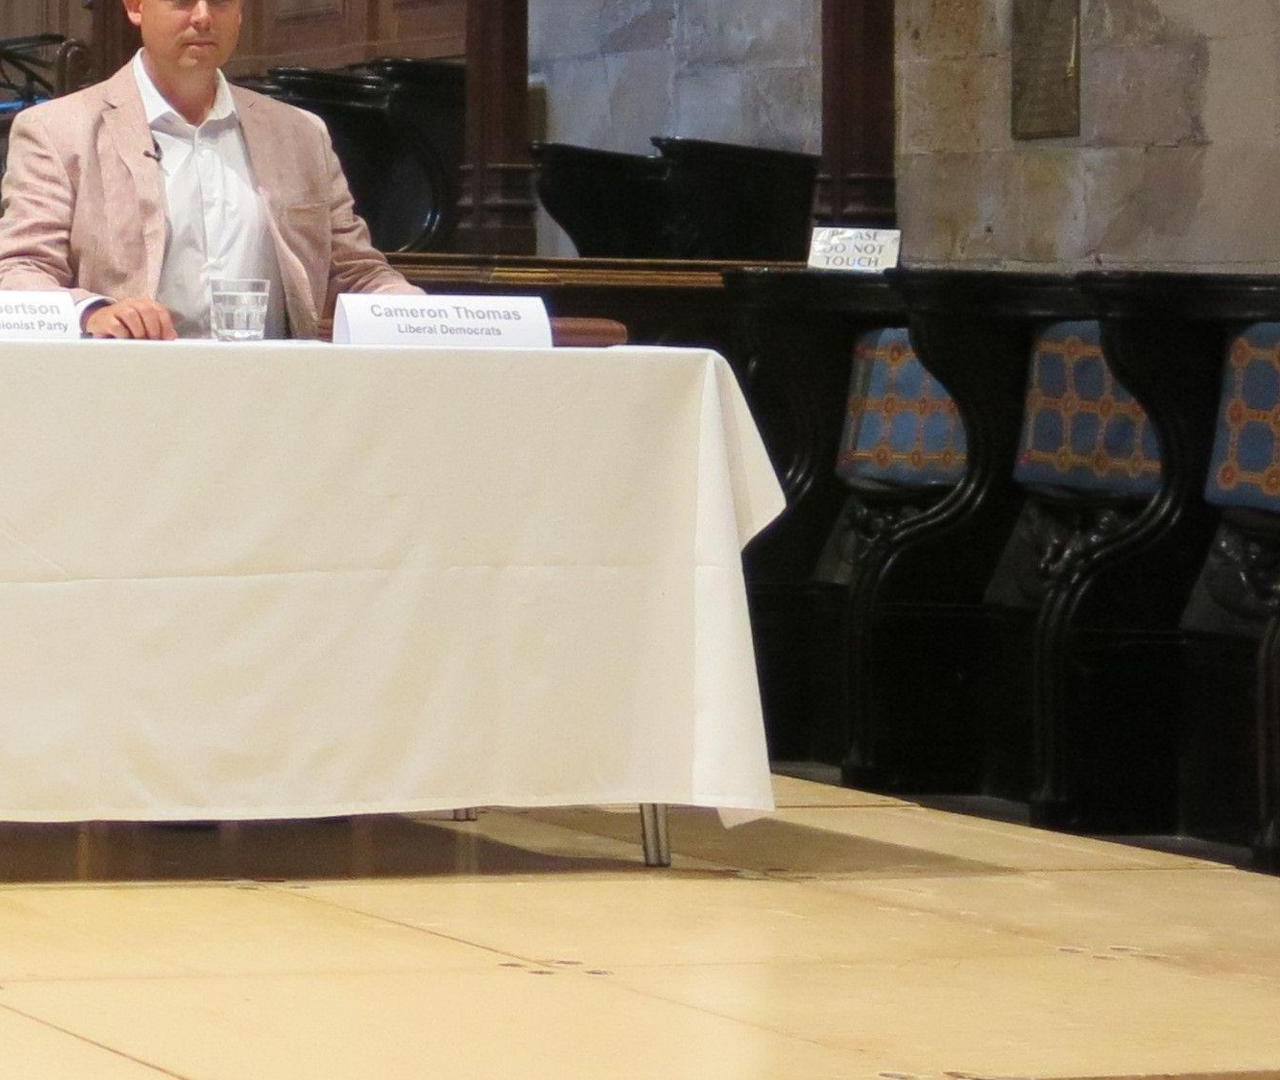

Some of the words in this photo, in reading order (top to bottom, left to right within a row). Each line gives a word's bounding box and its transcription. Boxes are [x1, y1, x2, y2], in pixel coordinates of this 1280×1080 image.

[853, 244, 886, 256] NOT
[824, 256, 881, 267] TOUCH
[370, 304, 448, 319] Cameron
[453, 306, 522, 321] Thomas
[38, 322, 69, 333] Party
[397, 324, 437, 334] Liberal
[440, 324, 502, 336] Democrats
